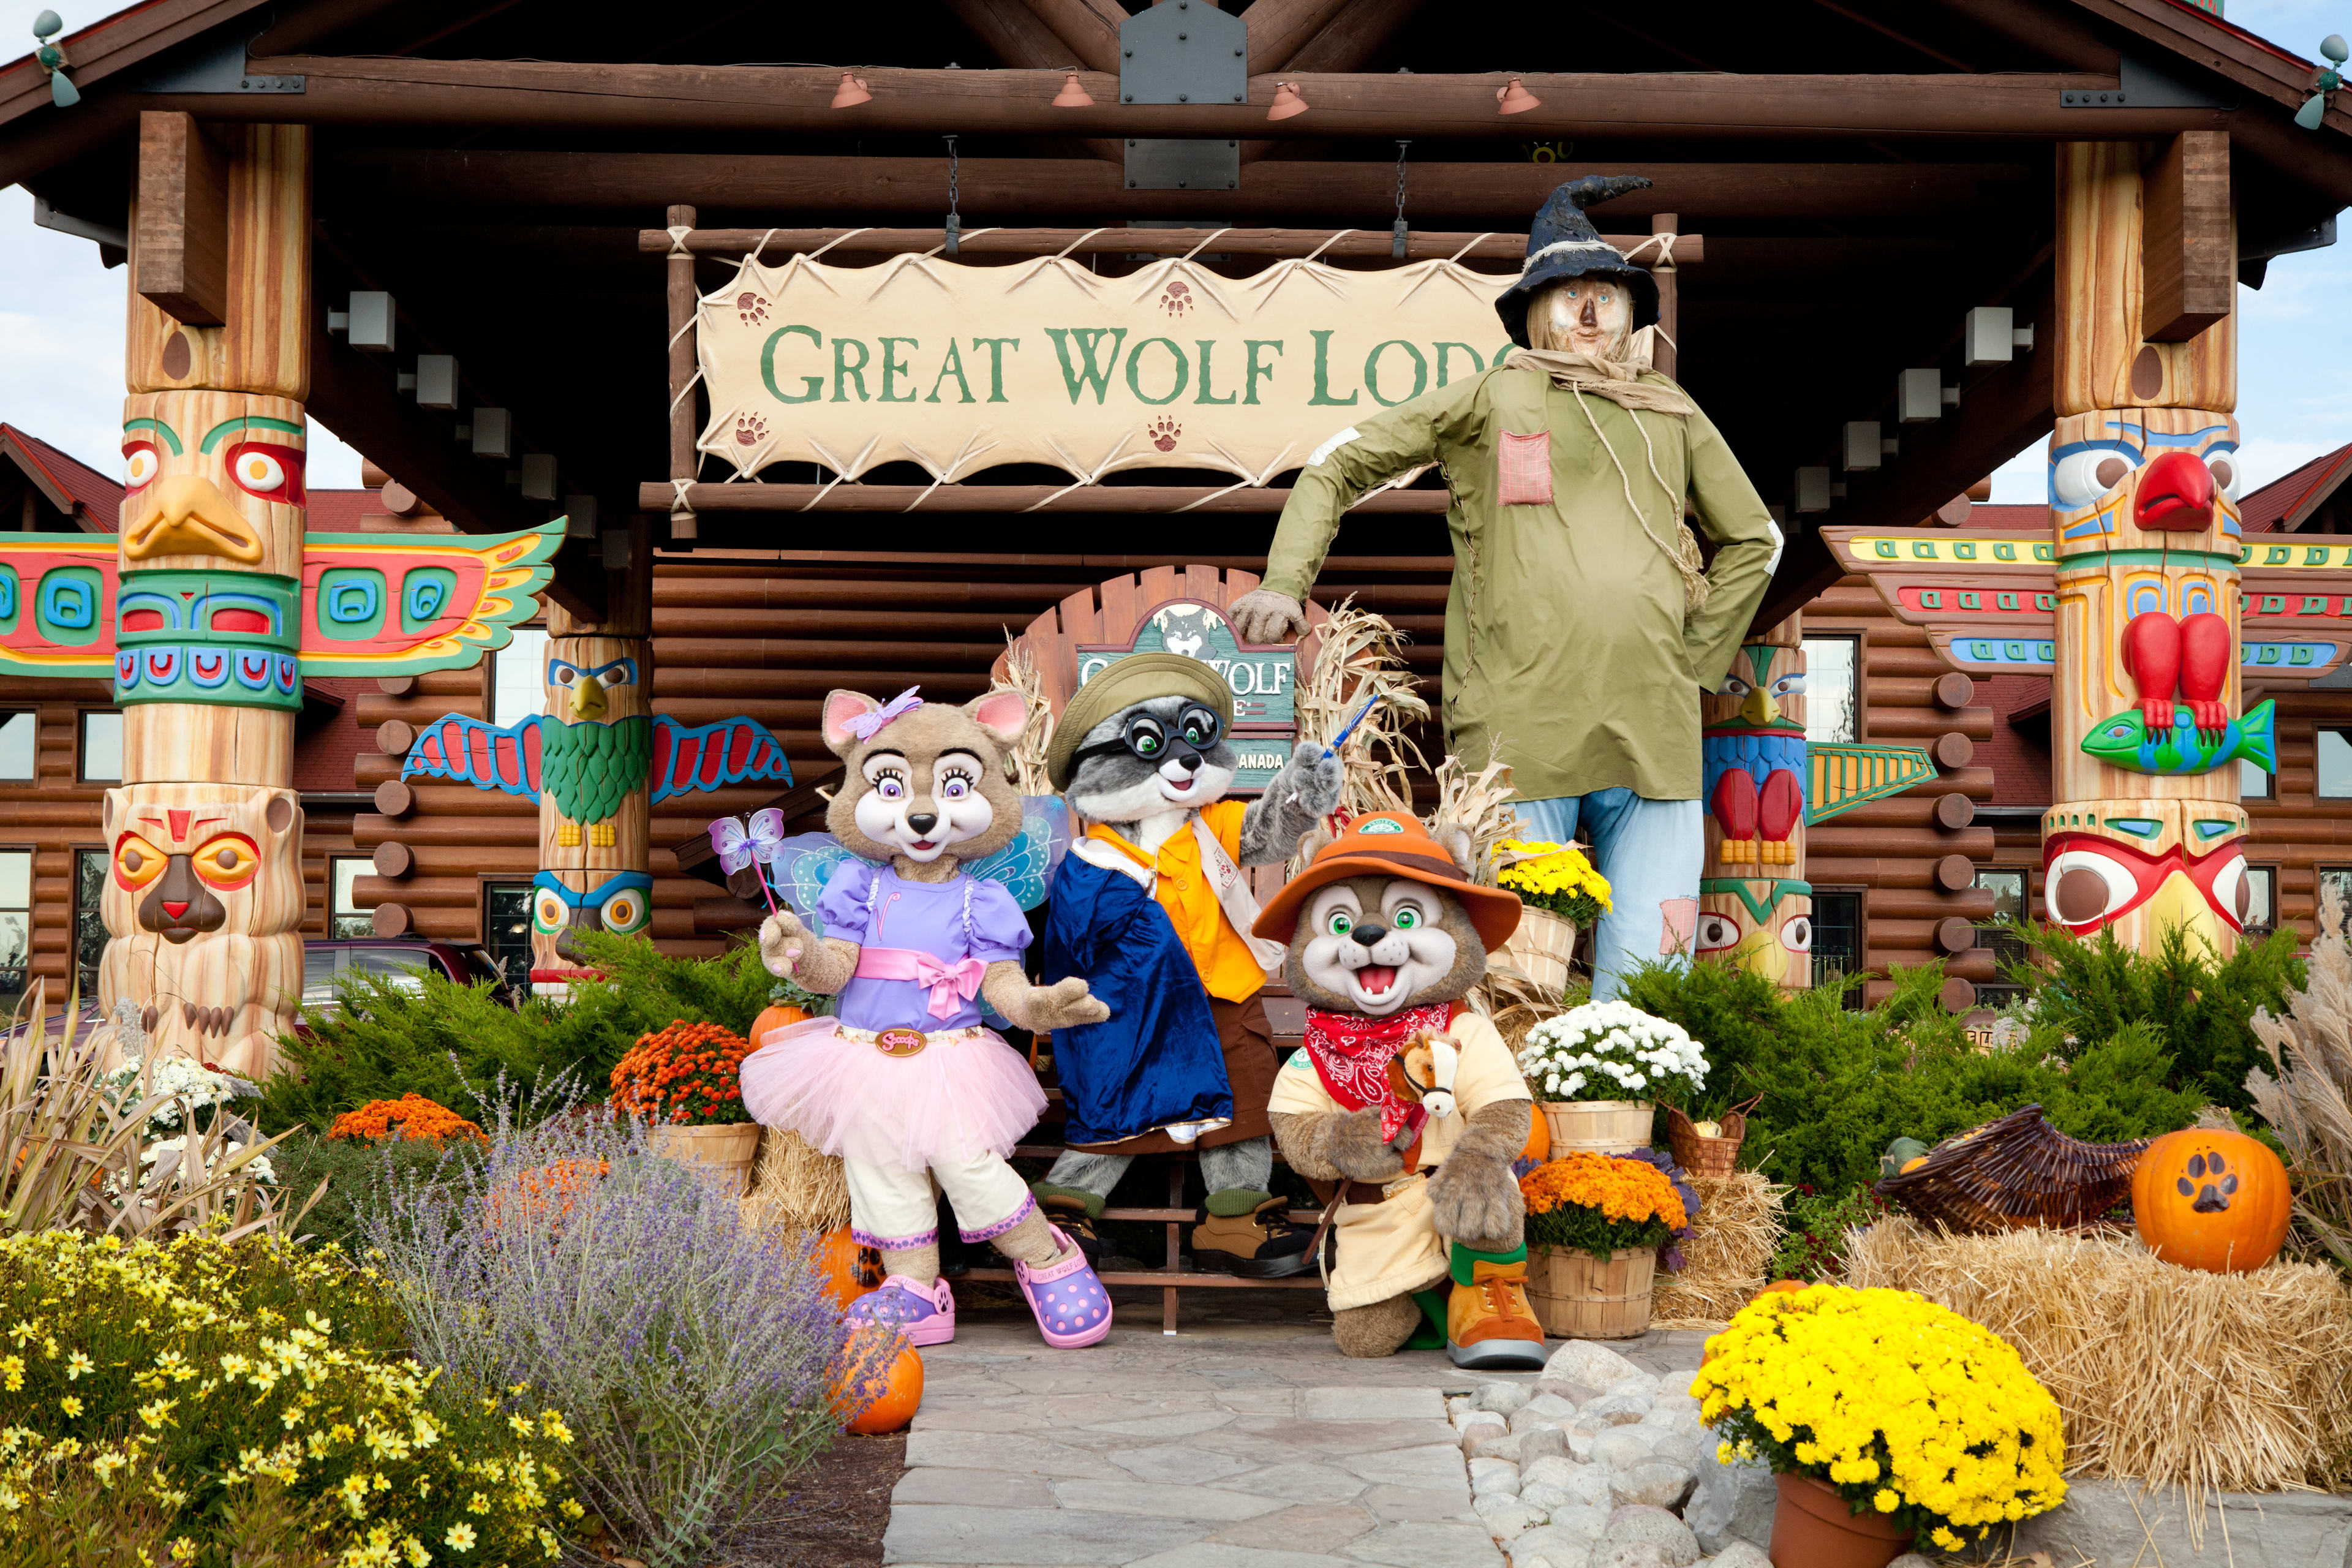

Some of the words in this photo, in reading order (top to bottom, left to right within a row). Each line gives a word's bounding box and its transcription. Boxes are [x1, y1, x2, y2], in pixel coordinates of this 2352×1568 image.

[760, 325, 1020, 404] GREAT
[1044, 327, 1284, 405] WOLF
[1307, 330, 1520, 407] LOD
[1237, 753, 1284, 769] ANADA
[875, 892, 901, 941] V
[1038, 1270, 1054, 1281] GREAT
[904, 1279, 925, 1294] LODGE
